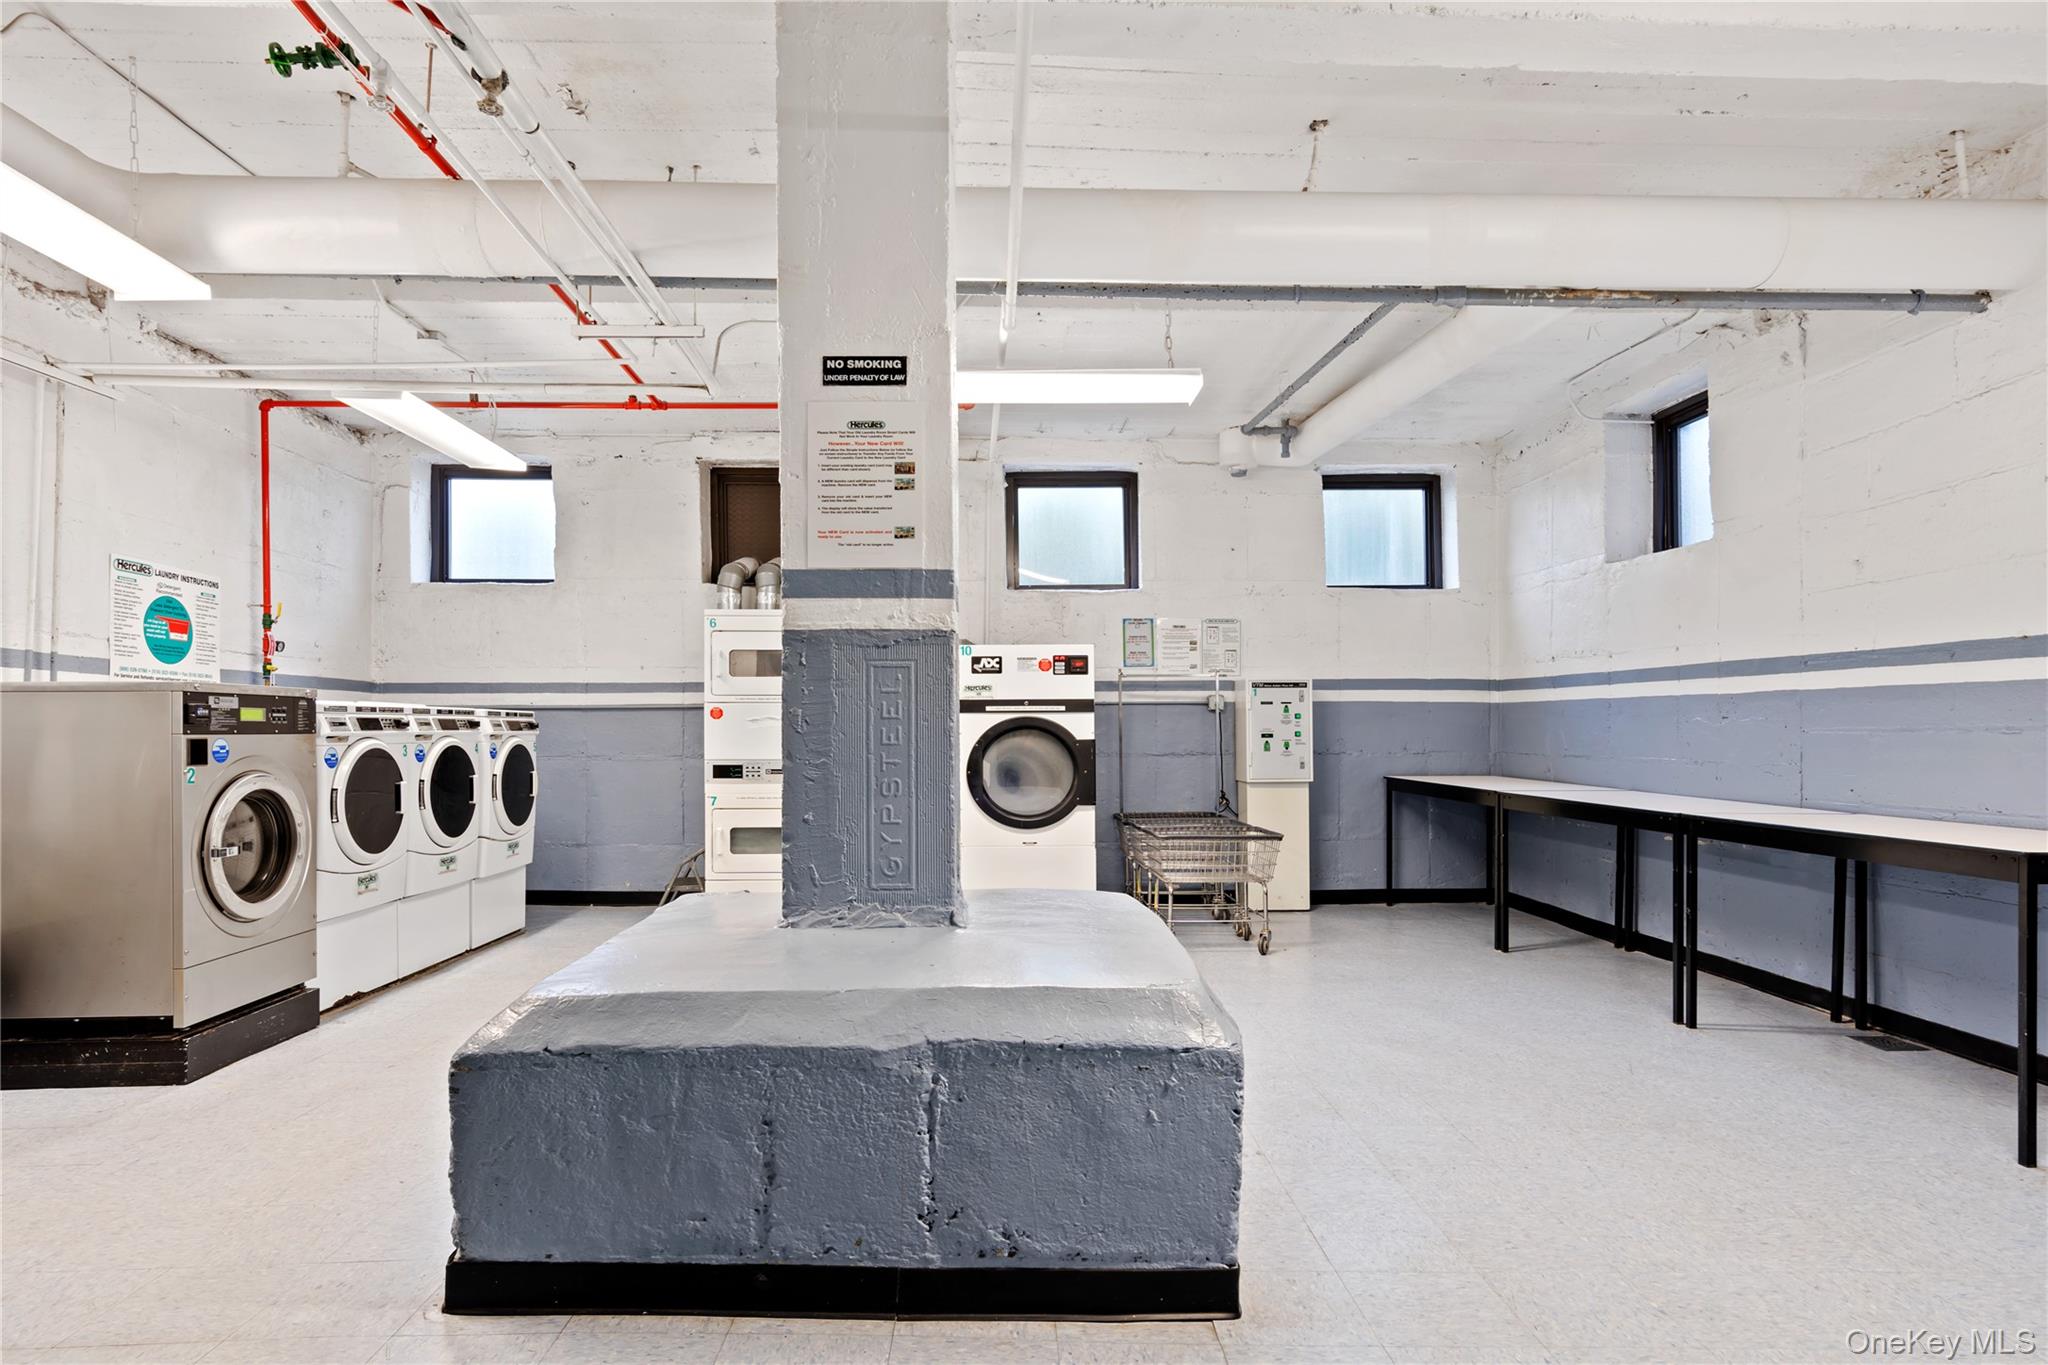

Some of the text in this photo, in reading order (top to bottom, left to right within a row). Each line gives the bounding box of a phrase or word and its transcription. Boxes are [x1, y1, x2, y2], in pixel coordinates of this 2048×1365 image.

[826, 360, 902, 368] NO SMOKING
[850, 420, 883, 429] Hercules
[116, 558, 152, 575] Hercules
[154, 569, 219, 589] LAUNDRY INSTRUCTIONS
[709, 618, 717, 628] 6
[961, 646, 972, 655] 10
[1253, 688, 1257, 696] 1
[403, 745, 408, 757] 3
[187, 768, 196, 784] 2
[880, 674, 902, 878] GYPSTEEL
[710, 796, 718, 806] 7
